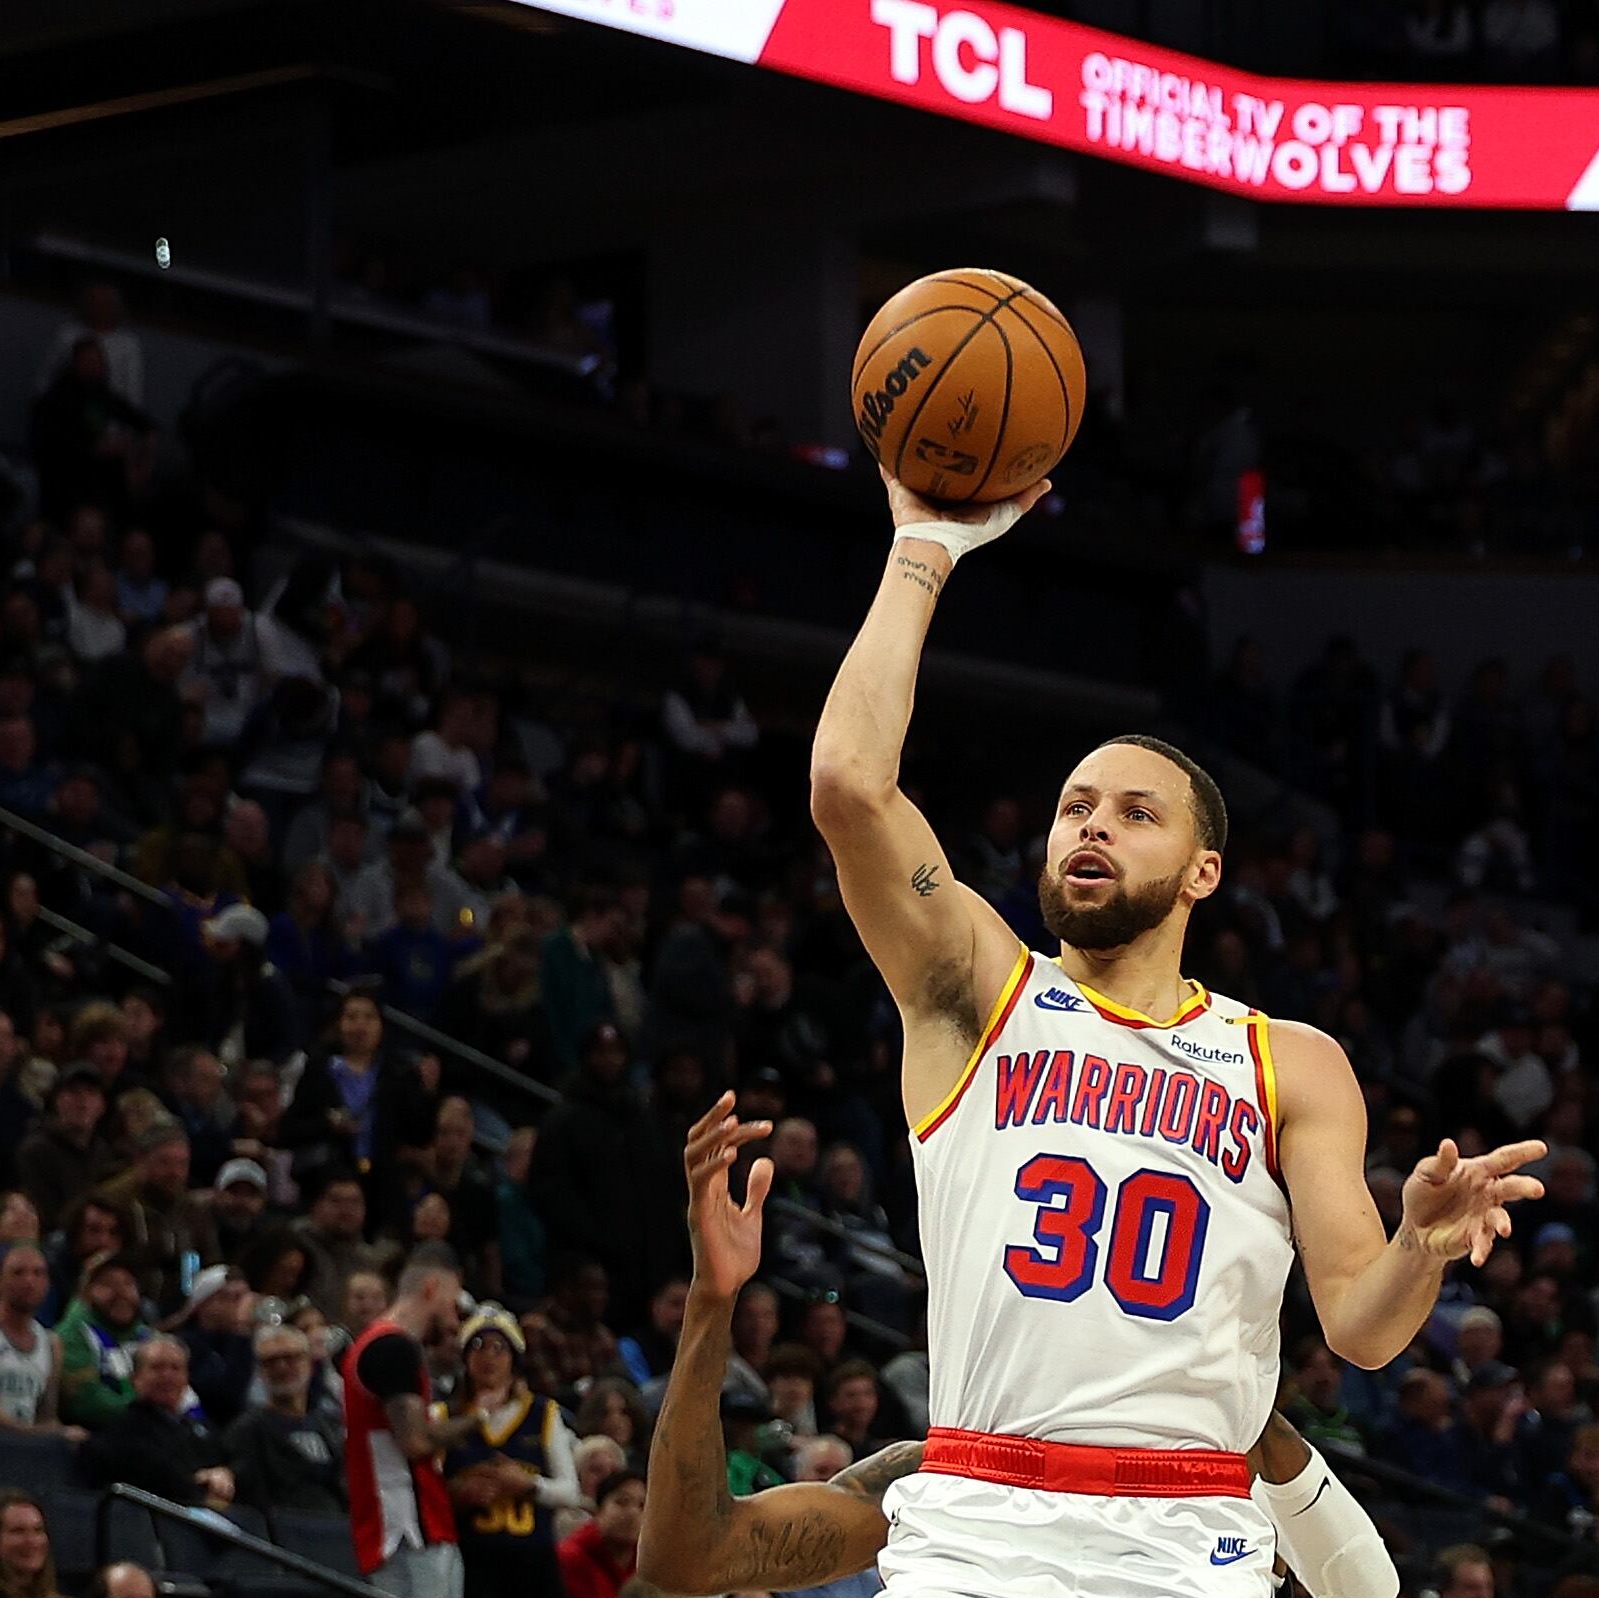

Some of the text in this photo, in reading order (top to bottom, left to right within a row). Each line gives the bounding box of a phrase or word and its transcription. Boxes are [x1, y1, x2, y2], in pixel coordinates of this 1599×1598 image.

[870, 0, 1053, 121] TCL
[1081, 52, 1471, 147] OFFICIAL TV OF THE
[1078, 90, 1472, 195] TIMBERWOLVES
[1044, 987, 1084, 1010] NIKE
[1171, 1034, 1244, 1065] Rakuten
[995, 1049, 1259, 1185] WARRIORS
[1002, 1152, 1211, 1323] 30
[1216, 1536, 1248, 1555] NIKE
